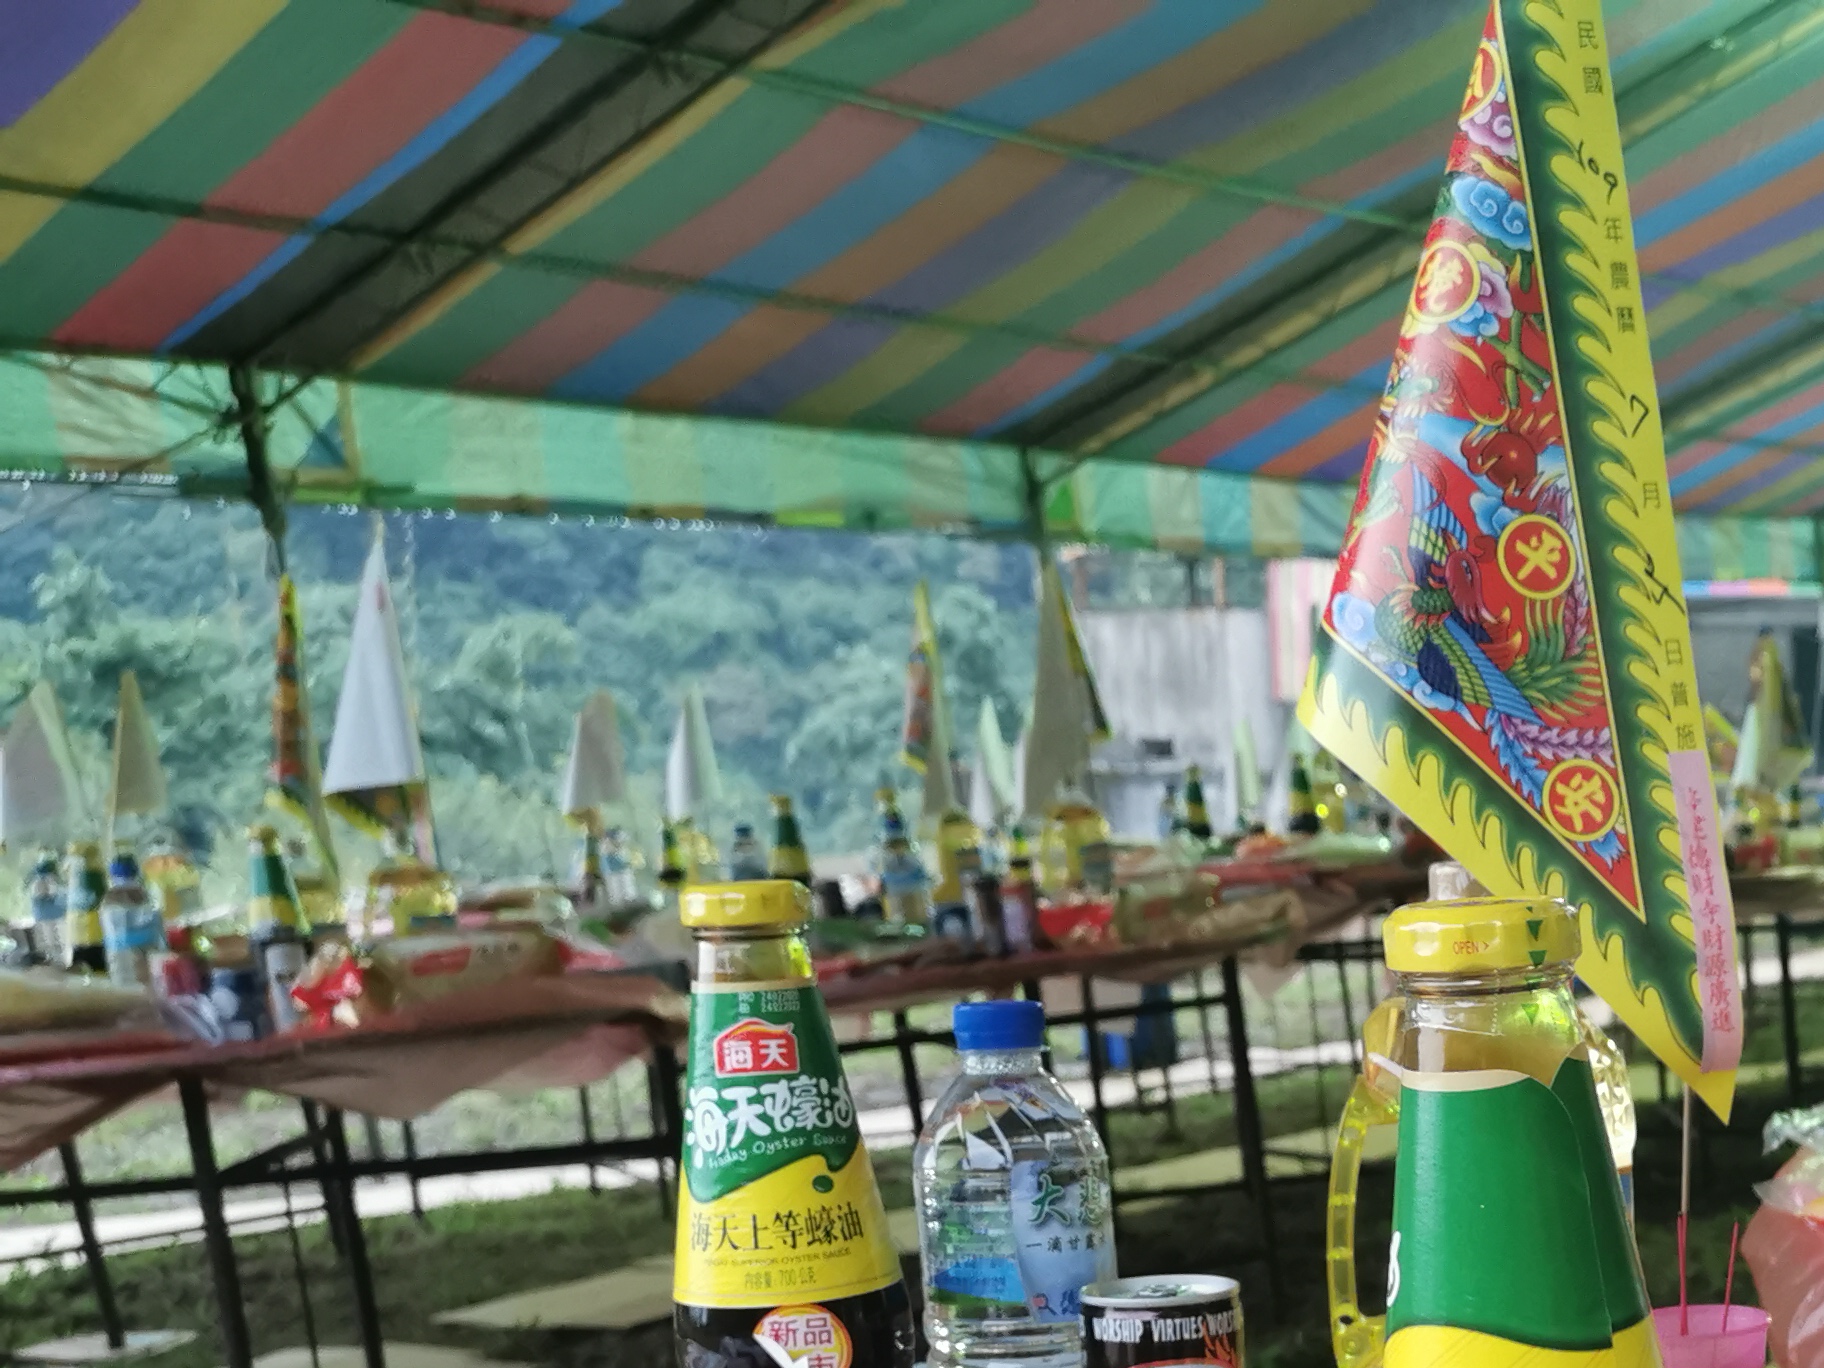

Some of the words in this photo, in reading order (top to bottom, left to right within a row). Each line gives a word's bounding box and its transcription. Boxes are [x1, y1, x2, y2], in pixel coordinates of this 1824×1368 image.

[1452, 940, 1480, 955] OPEN
[722, 1037, 791, 1072] 海天
[751, 1136, 808, 1156] Oyster
[690, 1201, 865, 1254] 海天上等蠔油
[766, 1314, 837, 1352] 新品
[1092, 1316, 1144, 1344] WORSHIP
[1151, 1317, 1205, 1343] VIRTUES
